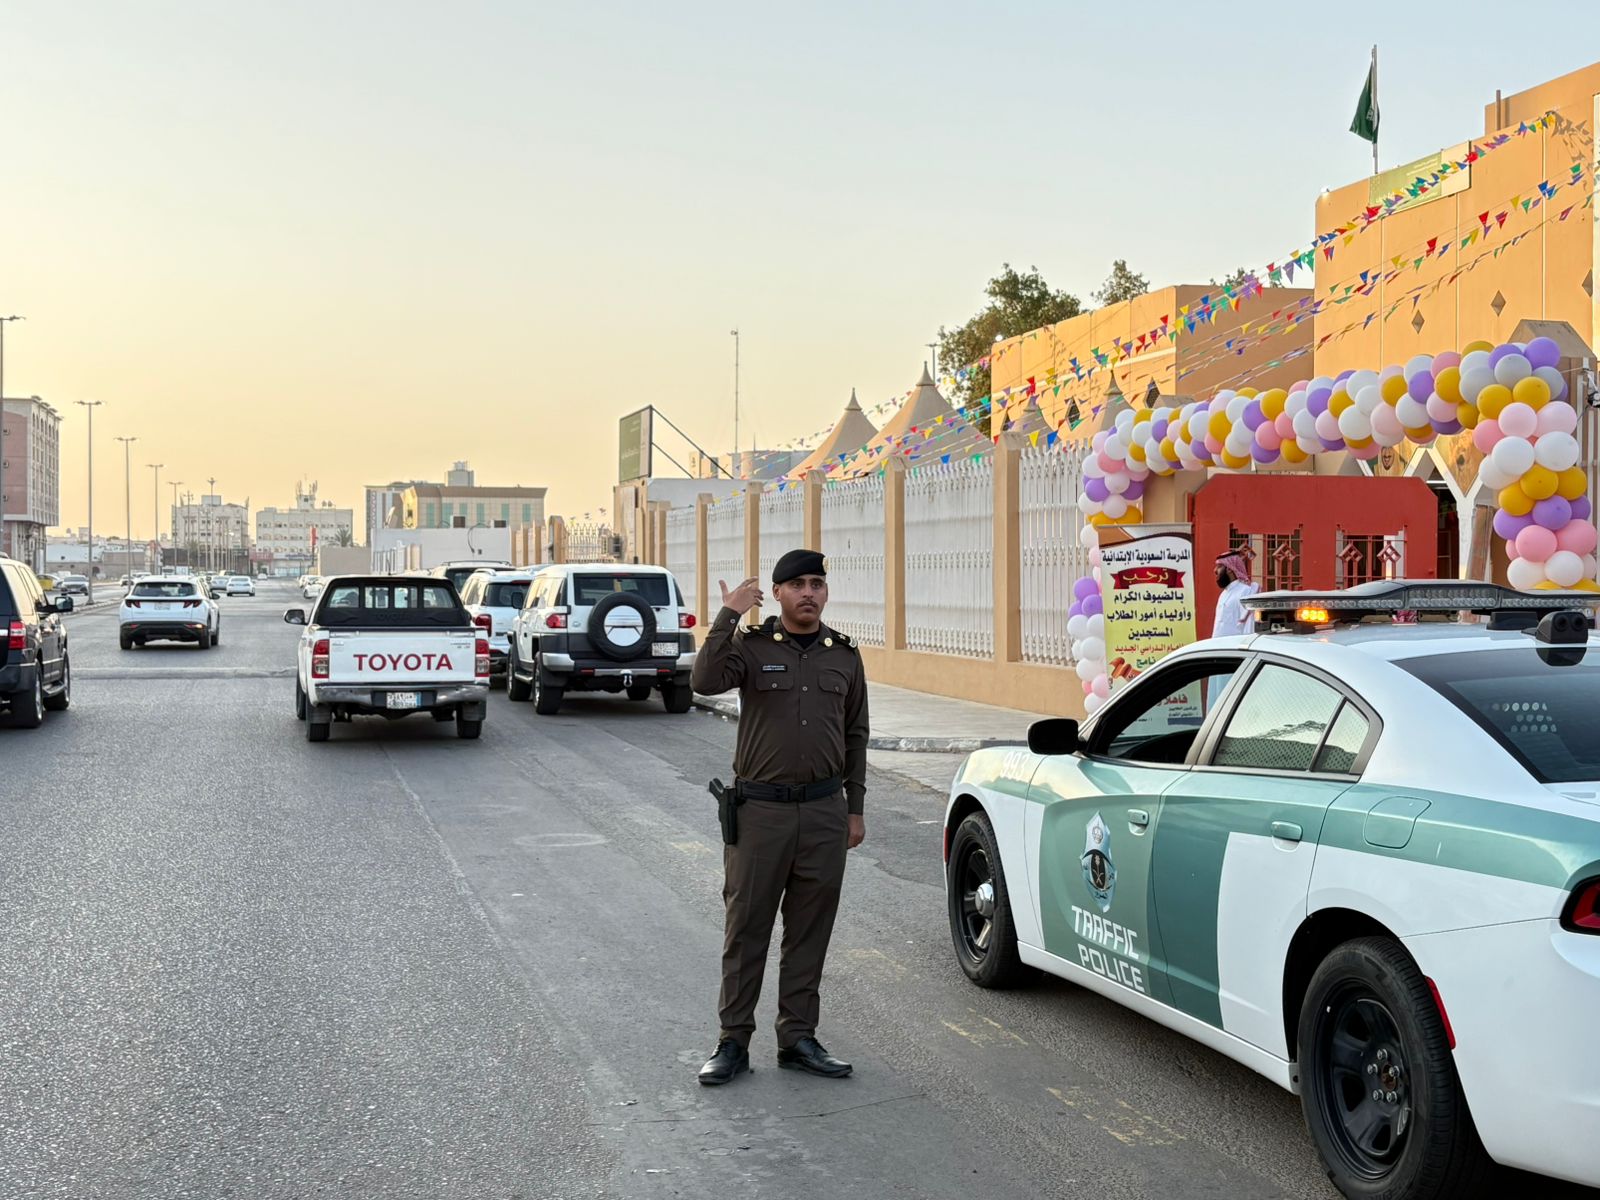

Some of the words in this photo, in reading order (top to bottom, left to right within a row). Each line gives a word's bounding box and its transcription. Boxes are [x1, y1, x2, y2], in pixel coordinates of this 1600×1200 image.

[1135, 549, 1165, 564] السعودية
[1166, 548, 1190, 562] المدرسة
[1114, 591, 1141, 604] الكرام
[1143, 590, 1184, 603] بالضيوف
[1107, 610, 1137, 622] الطلاب
[1140, 608, 1157, 621] أمور
[1159, 607, 1191, 621] وأولياء
[1128, 627, 1173, 641] المستجدين
[1114, 644, 1139, 655] الجديد
[1140, 643, 1166, 655] الدراسي
[353, 653, 453, 671] TOYOTA
[1136, 656, 1157, 668] نامج
[1071, 905, 1140, 960] TRAFFIC
[1077, 943, 1145, 993] POLICE
